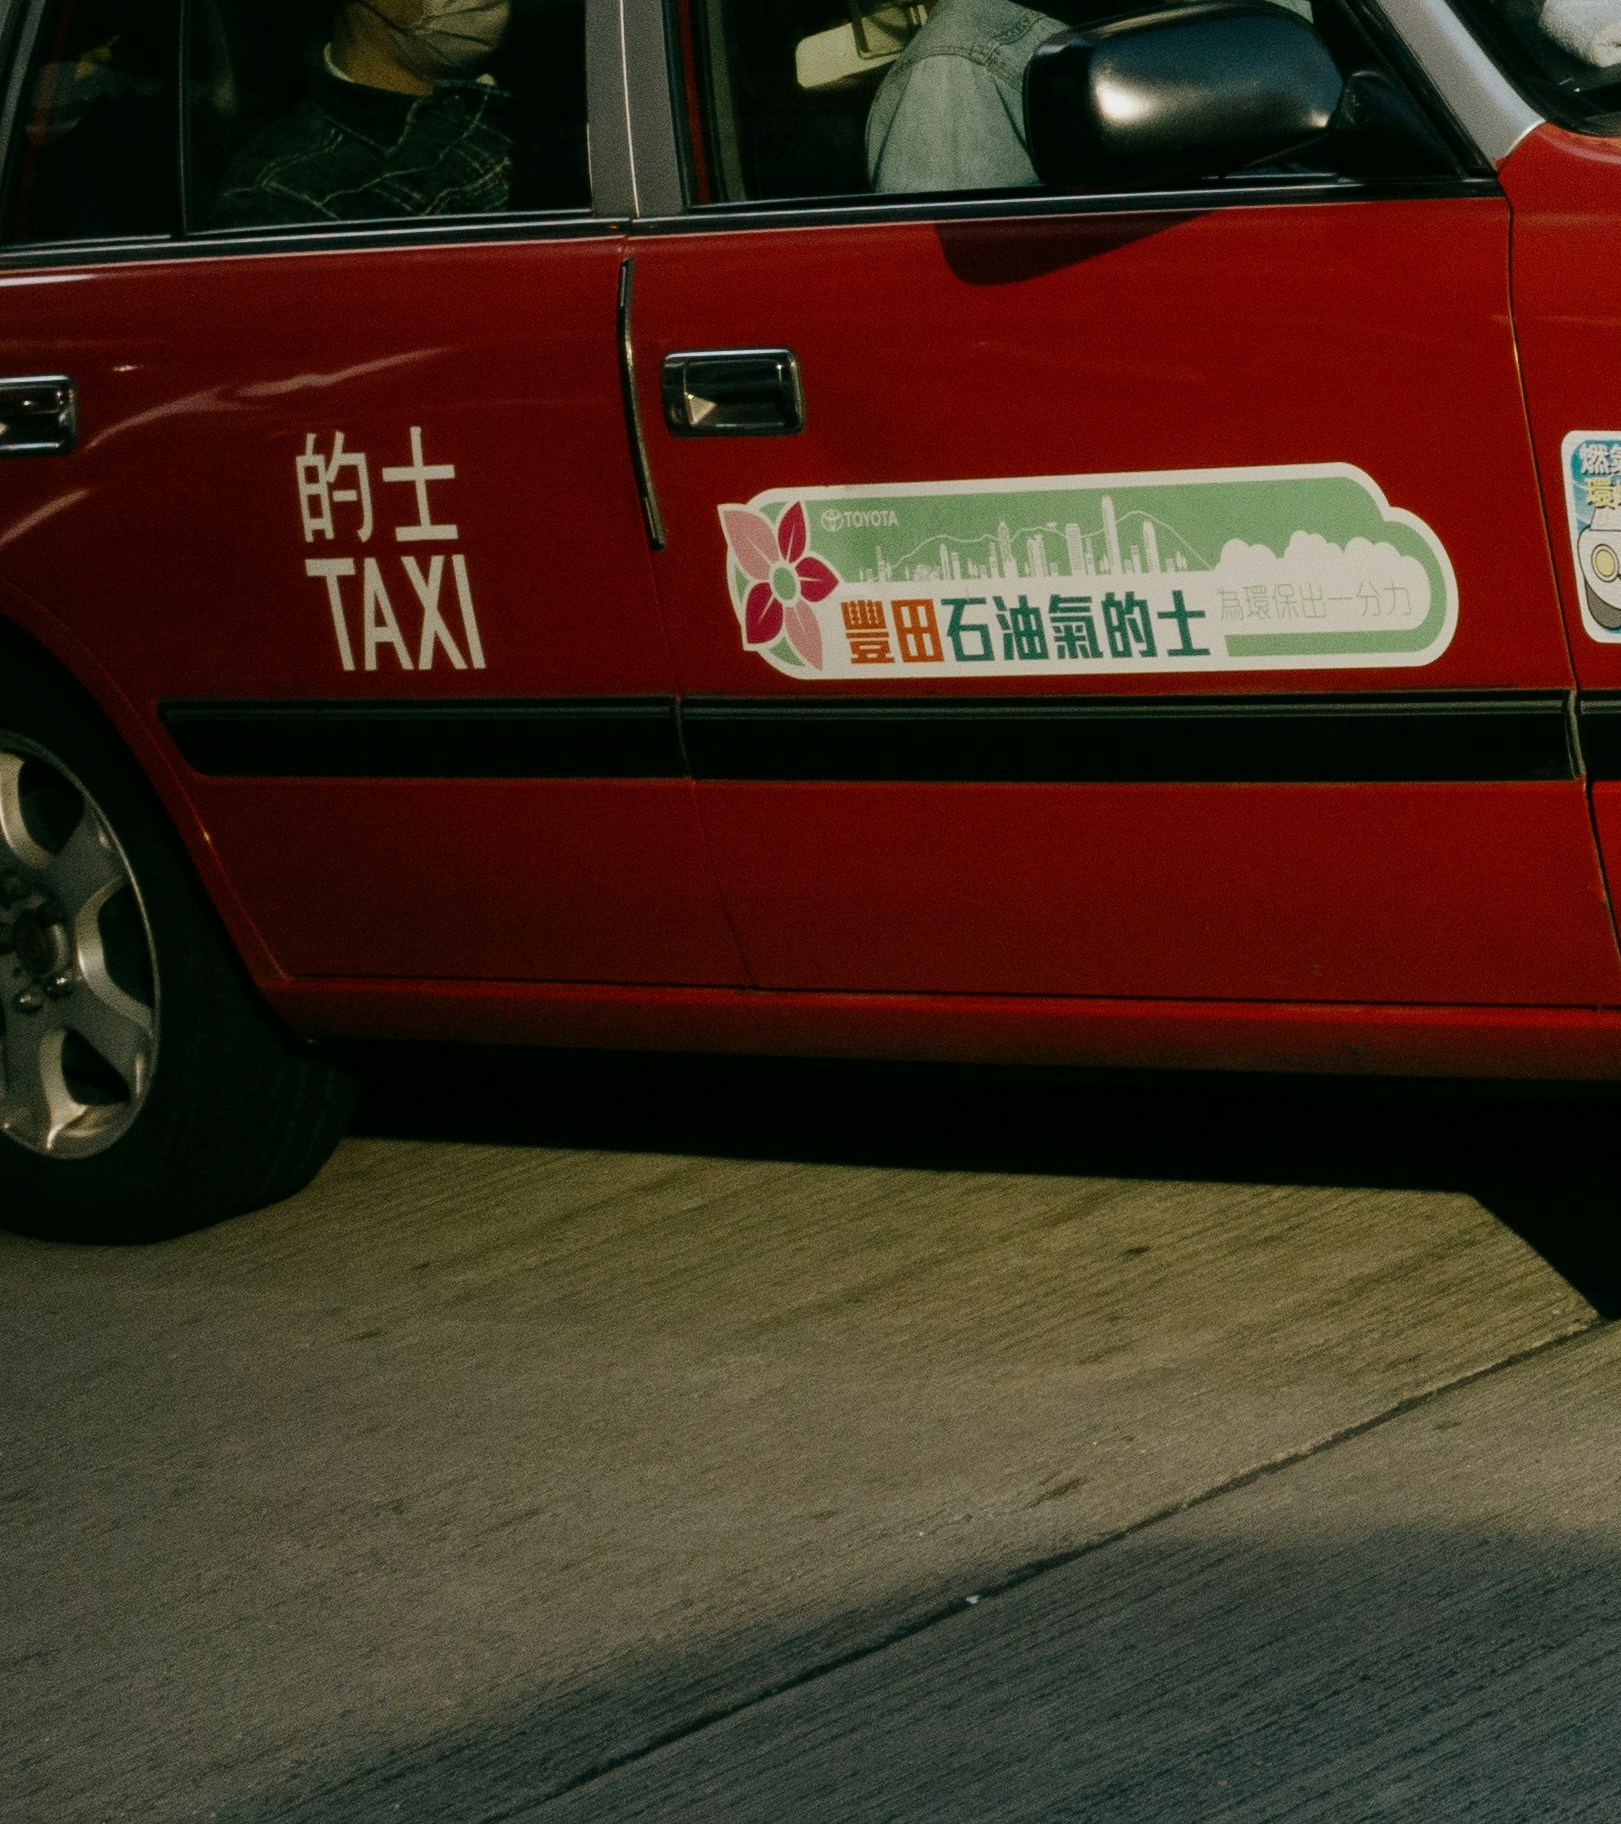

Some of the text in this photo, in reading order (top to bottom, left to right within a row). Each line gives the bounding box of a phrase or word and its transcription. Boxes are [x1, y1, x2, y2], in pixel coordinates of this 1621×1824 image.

[295, 426, 458, 543] 的士
[844, 508, 899, 529] TOYOTA
[305, 554, 486, 672] TAXI
[841, 589, 1211, 666] 豐田石油氣的士
[1216, 580, 1413, 623] 為環保出一分力
